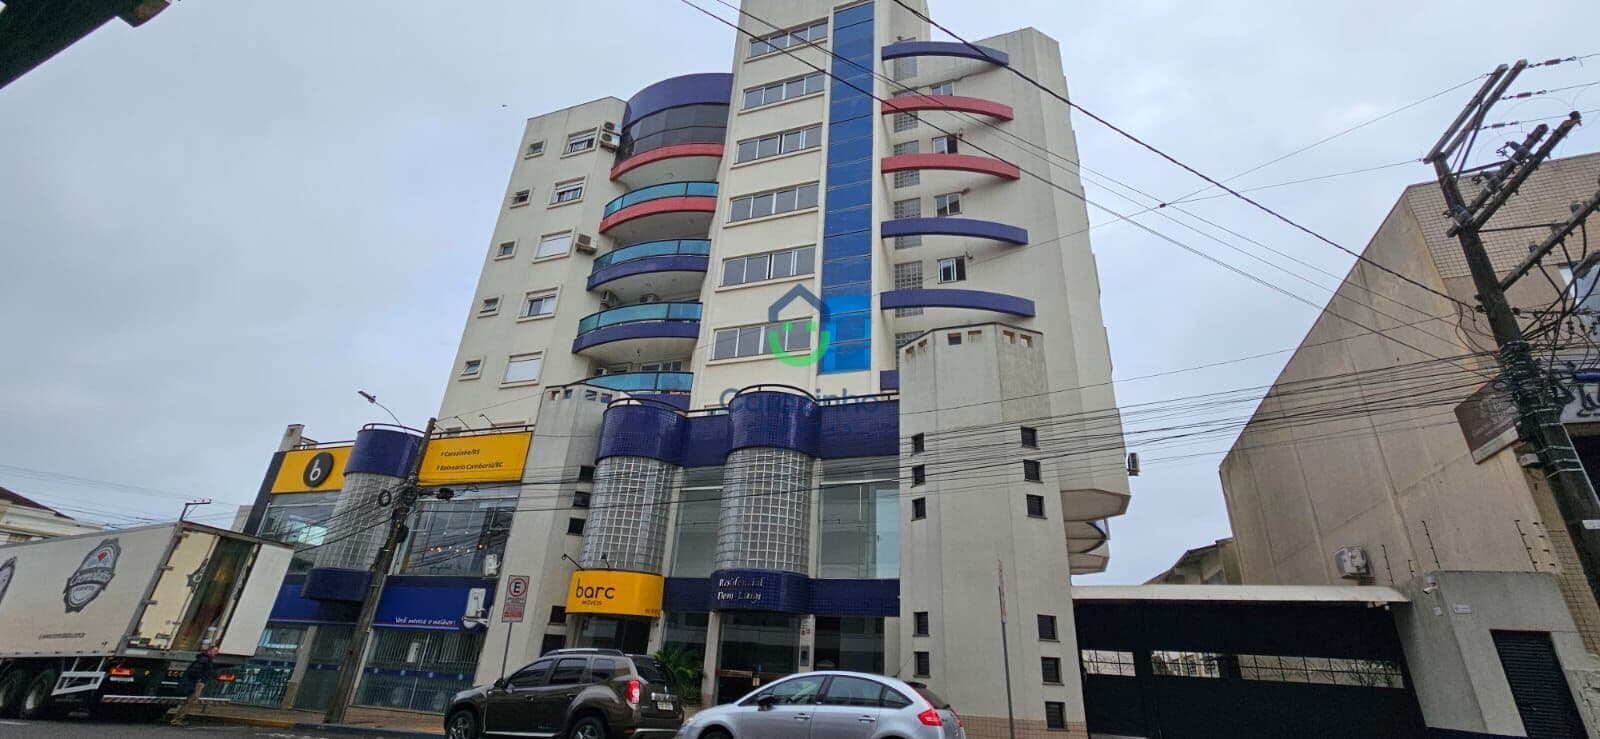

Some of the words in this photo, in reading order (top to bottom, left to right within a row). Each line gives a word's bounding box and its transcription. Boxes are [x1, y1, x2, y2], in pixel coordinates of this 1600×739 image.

[310, 459, 321, 481] b
[514, 581, 521, 593] E
[576, 578, 615, 599] barc
